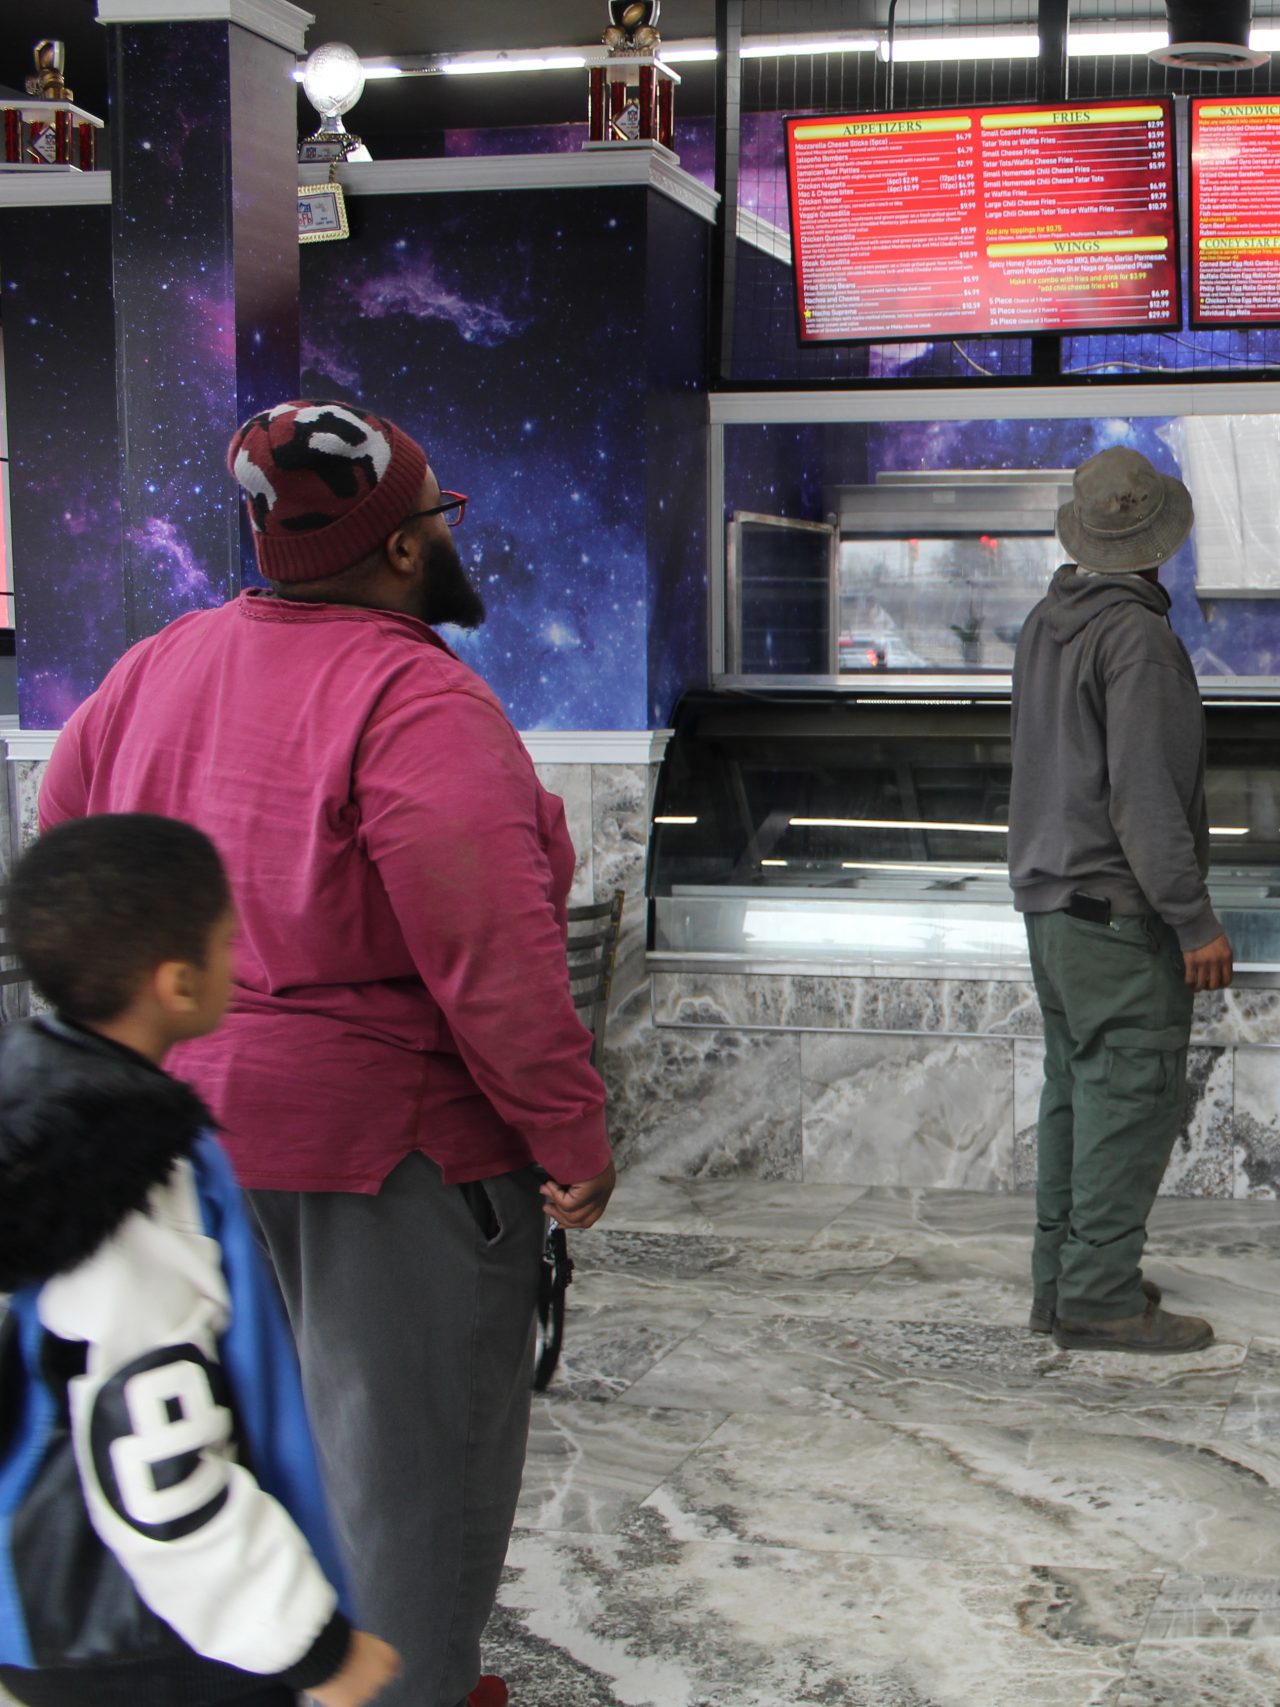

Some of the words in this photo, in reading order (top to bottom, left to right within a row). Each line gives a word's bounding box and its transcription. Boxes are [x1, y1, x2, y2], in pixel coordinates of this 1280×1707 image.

[1053, 111, 1090, 123] FRIES
[843, 121, 923, 135] APPETIZERS
[1148, 120, 1164, 129] $2.99
[998, 139, 1011, 147] Tots
[1148, 131, 1164, 139] $3.99
[1000, 149, 1023, 157] Cheese
[1148, 141, 1165, 149] $3.99
[999, 158, 1033, 167] Tots/Waffle
[1035, 157, 1057, 165] Cheese
[1152, 151, 1165, 159] 3.99
[983, 170, 1001, 178] Small
[1001, 168, 1035, 177] Homemade
[821, 181, 846, 189] Nuggets
[984, 180, 1001, 188] Small
[1002, 178, 1036, 187] Homemade
[1051, 177, 1074, 185] Cheese
[1091, 175, 1104, 183] Tots
[985, 201, 1001, 209] Large
[985, 211, 1002, 219] Large
[1018, 209, 1040, 217] Cheese
[1041, 208, 1056, 216] Tator
[1078, 206, 1098, 214] Waffle
[1148, 202, 1167, 211] $10.79
[1054, 240, 1100, 252] WINGS
[1205, 238, 1241, 248] CONEY
[1244, 237, 1270, 247] STAR
[1150, 300, 1169, 308] $12.99
[999, 317, 1017, 325] Piece
